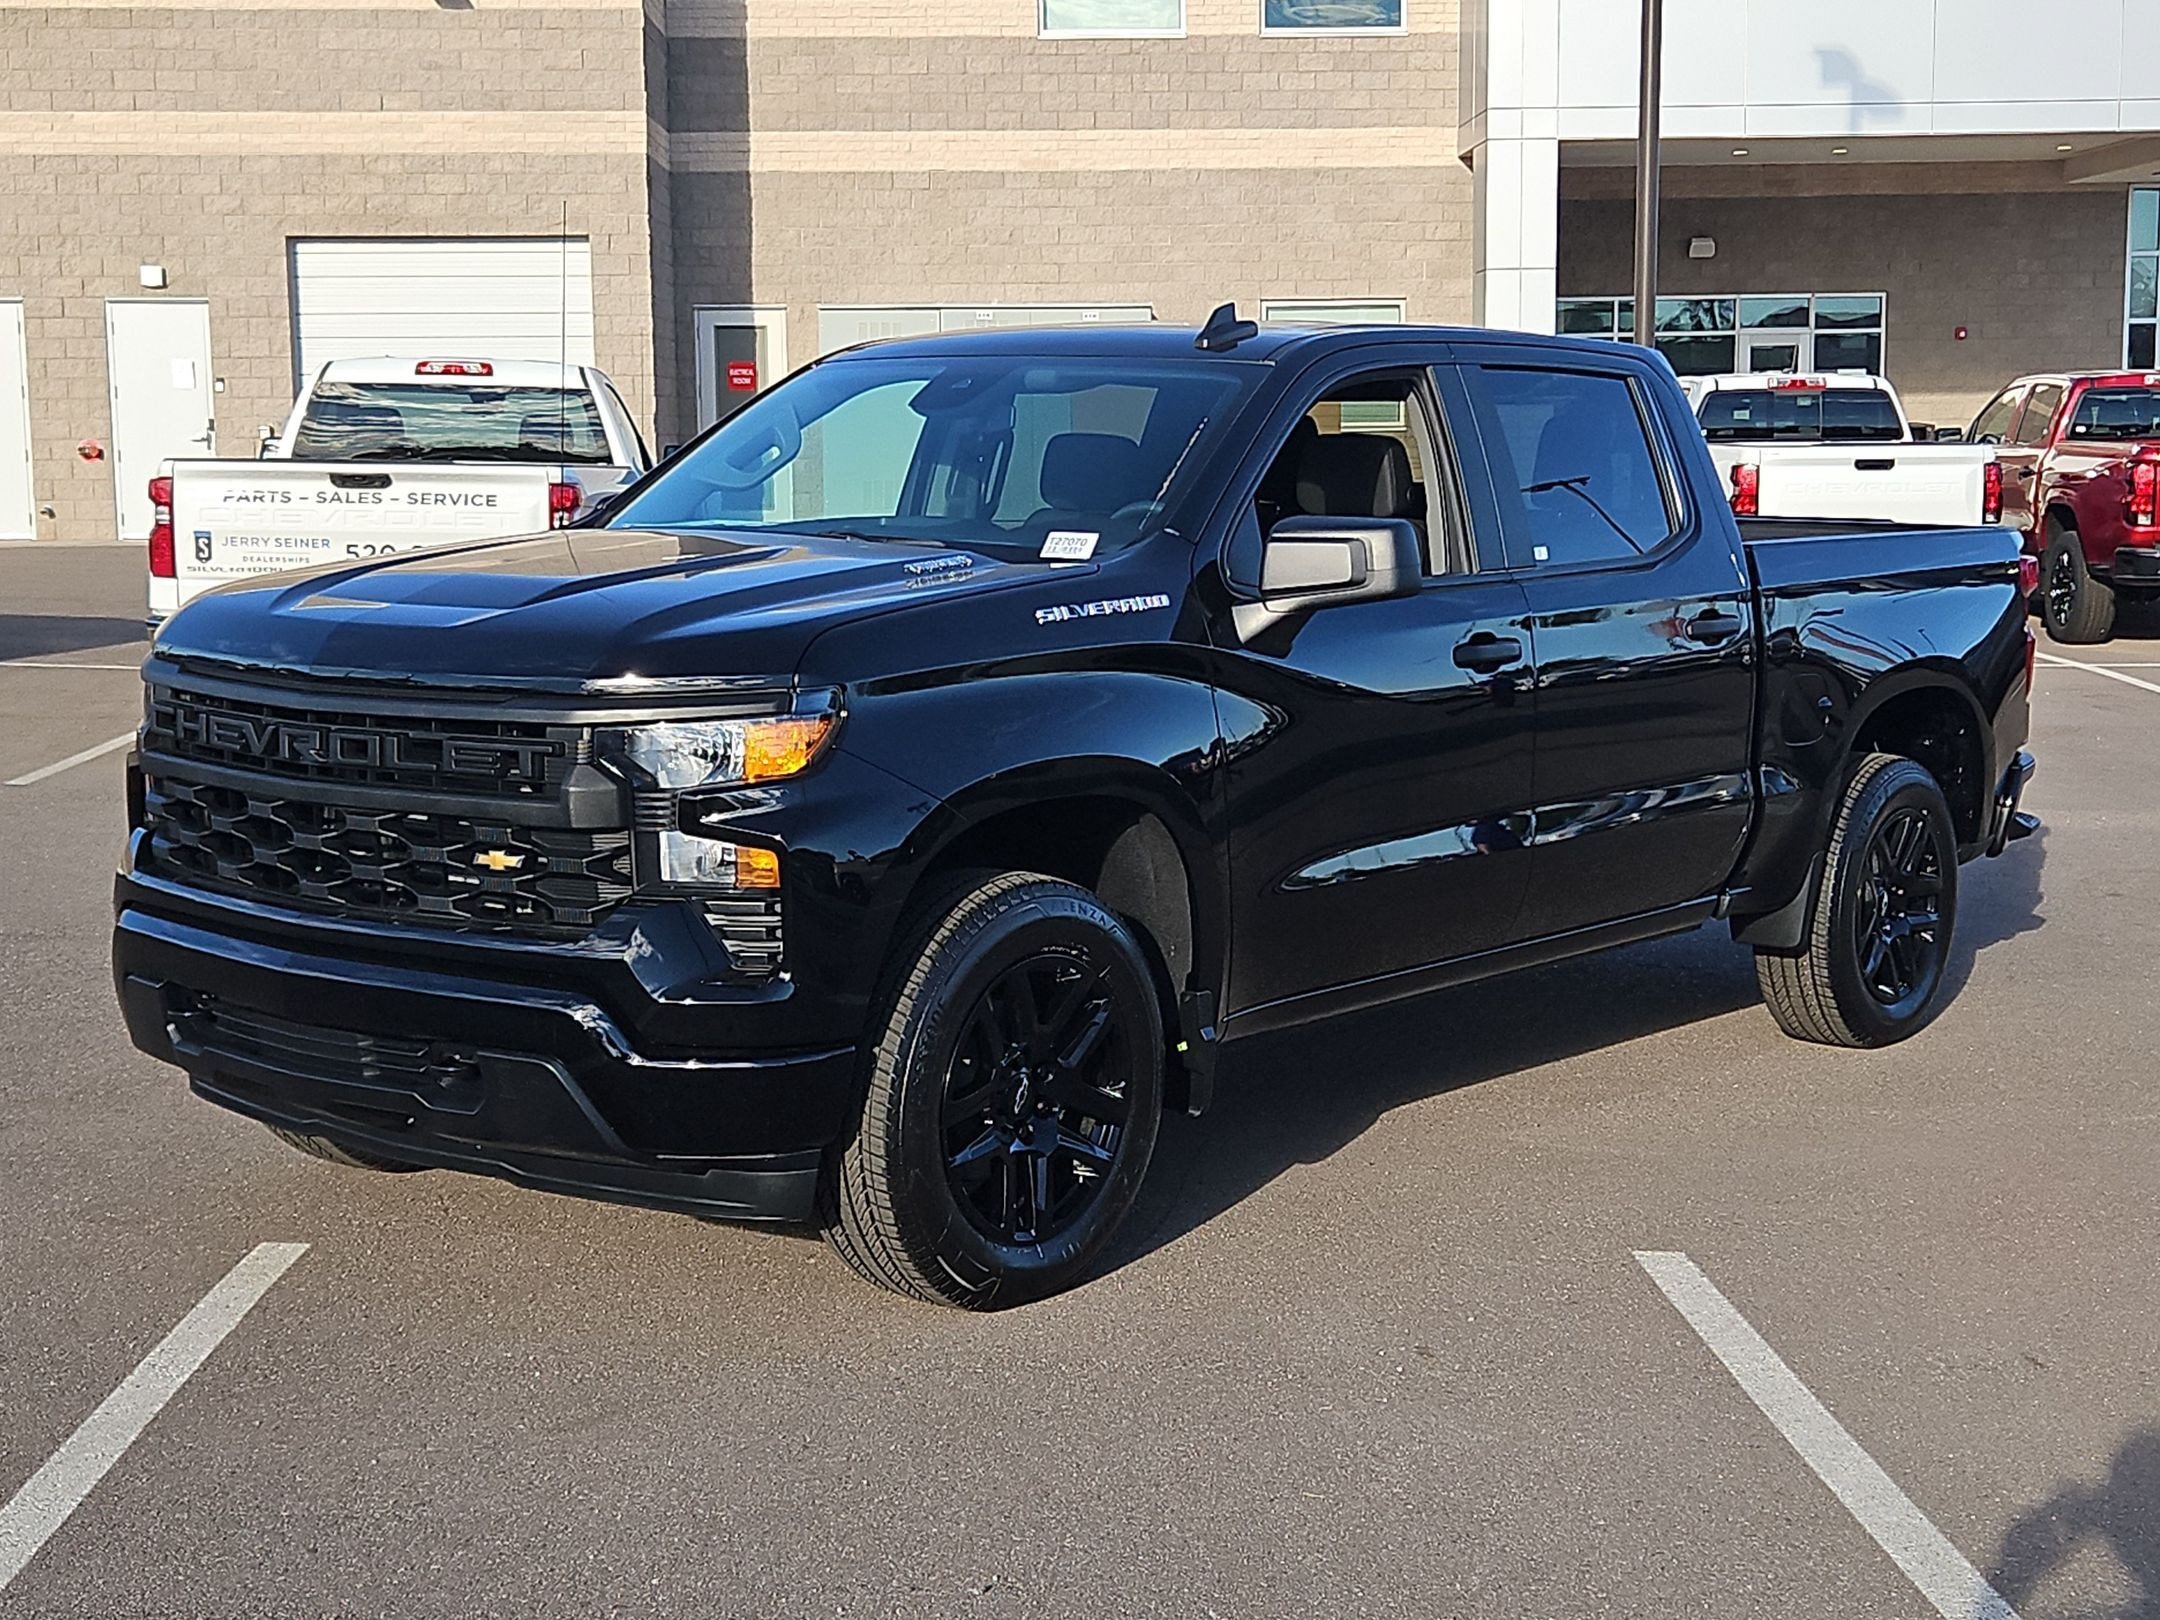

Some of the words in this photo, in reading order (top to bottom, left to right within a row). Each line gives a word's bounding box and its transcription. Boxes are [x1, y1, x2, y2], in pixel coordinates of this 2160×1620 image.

[1784, 481, 1961, 496] CHEVROLET
[223, 490, 292, 503] PARTS
[315, 491, 383, 504] SALES
[407, 492, 498, 507] SERVICE
[222, 536, 270, 547] JERRY
[274, 538, 331, 549] SEINER
[1050, 537, 1088, 546] T27070
[242, 555, 311, 564] DEALERSHIPS
[1035, 594, 1170, 625] SILVERADO
[149, 700, 567, 781] CHEVROLET
